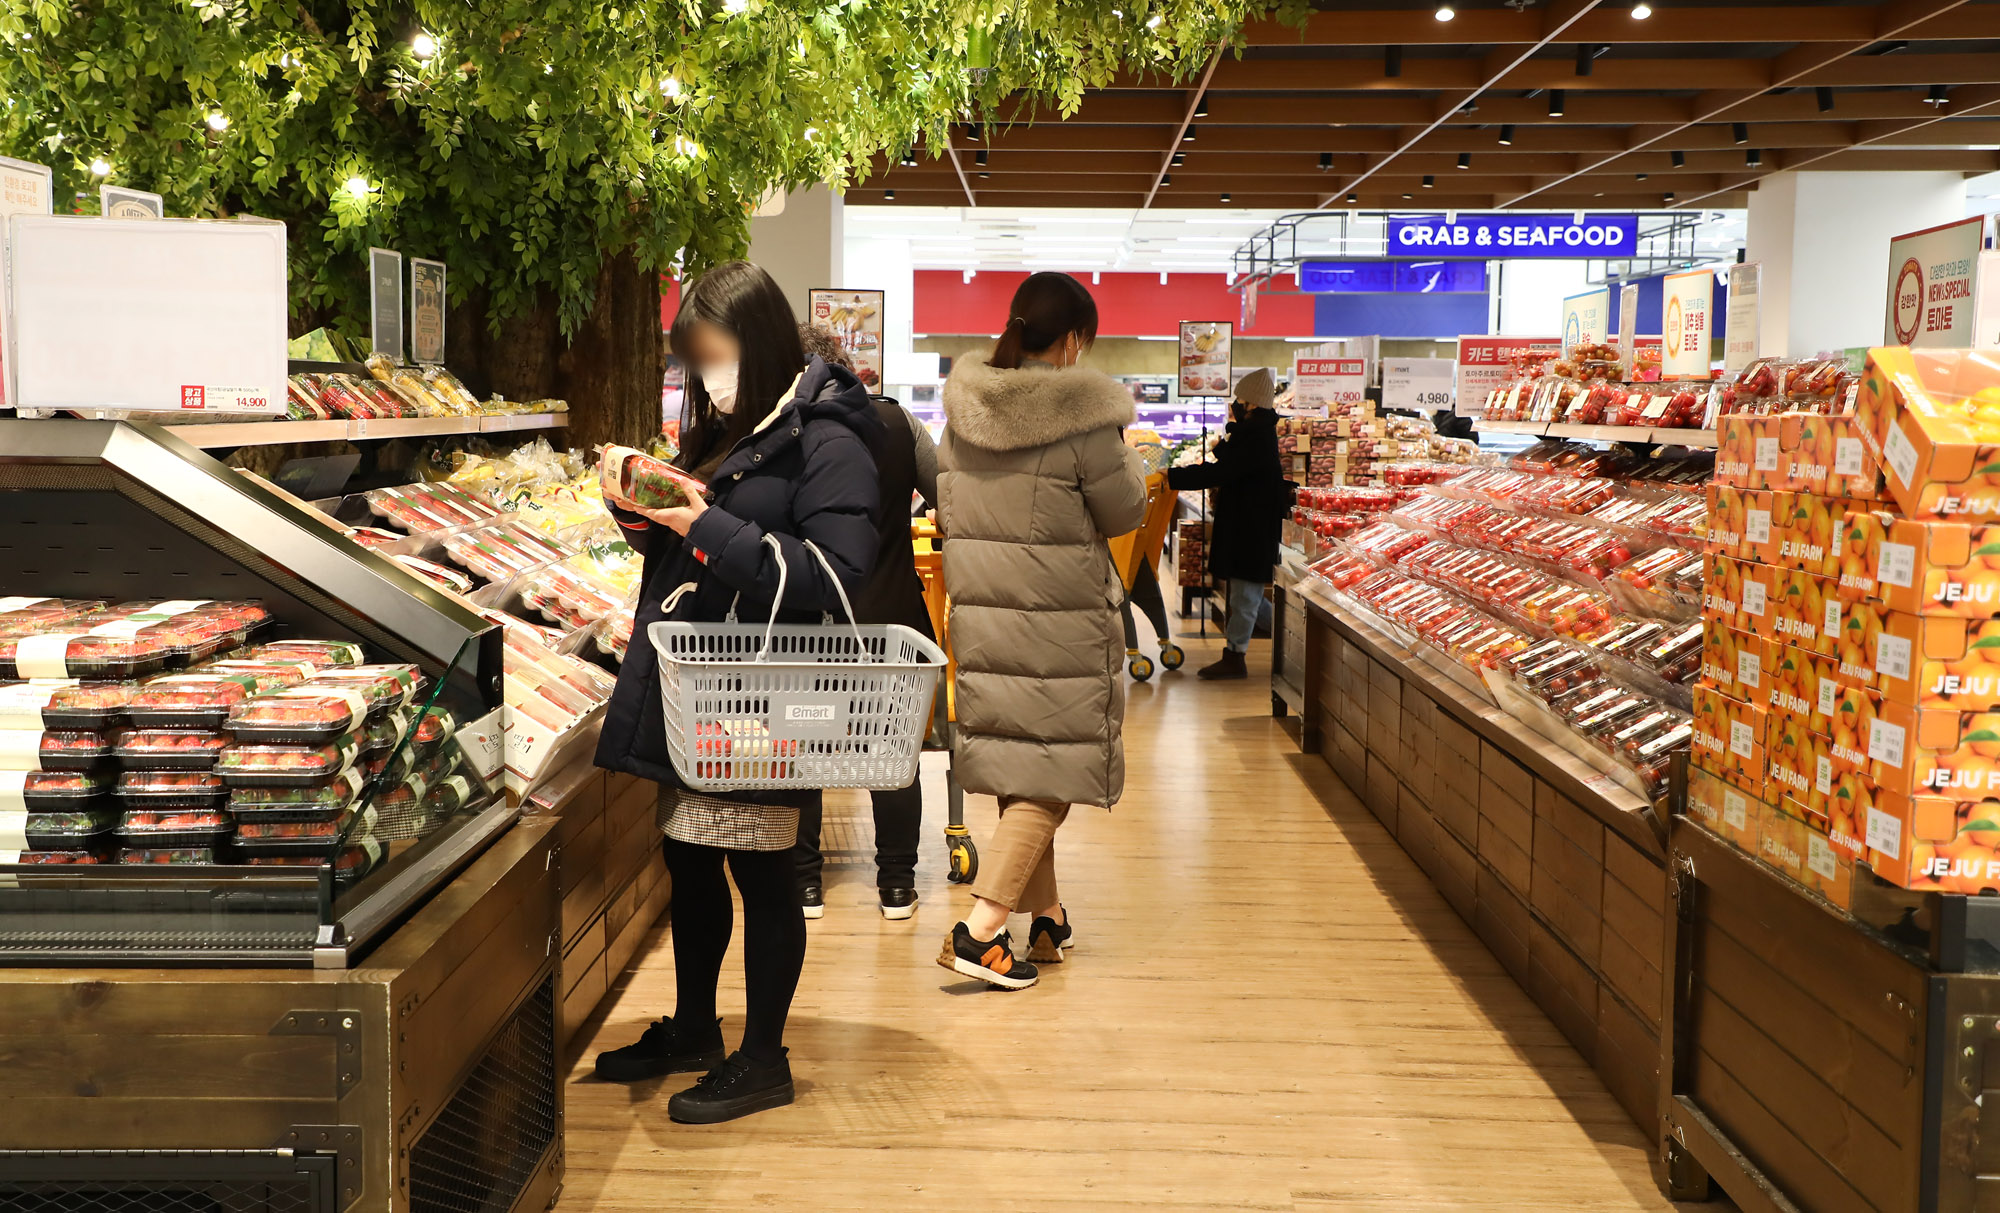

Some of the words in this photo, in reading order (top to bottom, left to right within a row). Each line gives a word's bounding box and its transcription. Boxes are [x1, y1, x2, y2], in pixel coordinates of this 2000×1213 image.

[1399, 226, 1470, 246] CRAB
[1475, 226, 1492, 246] &
[1497, 226, 1624, 246] SEAFOOD
[1929, 262, 1945, 280] 다양한
[1945, 260, 1957, 277] 맛과
[1927, 305, 1953, 332] 토마토
[1684, 333, 1698, 352] 토마토
[1468, 347, 1493, 362] 카드
[1301, 363, 1318, 373] 광고
[1319, 363, 1337, 373] 상품
[185, 387, 201, 397] 광고
[185, 397, 202, 406] 상품
[236, 397, 267, 407] 14,900
[1333, 391, 1361, 401] 7,900
[1416, 392, 1449, 404] 4,980
[1716, 461, 1732, 476] JEJU
[1731, 462, 1749, 477] FARM
[1787, 463, 1806, 477] JEJU
[1805, 464, 1827, 480] FARM
[1930, 494, 1992, 515] JEJU
[1706, 528, 1721, 543] JEJU
[1721, 531, 1739, 546] FARM
[1780, 540, 1800, 557] JEJU
[1800, 543, 1823, 562] FARM
[1839, 573, 1855, 588] JEJU
[1855, 575, 1873, 592] FARM
[1932, 581, 1993, 603] JEJU
[1703, 594, 1718, 610] JEJU
[1718, 597, 1736, 615] FARM
[1773, 615, 1793, 634] JEJU
[1793, 619, 1816, 640] FARM
[1702, 662, 1716, 680] JEJU
[1716, 667, 1732, 685] FARM
[1839, 662, 1855, 677] JEJU
[1854, 665, 1873, 682] FARM
[1930, 675, 1990, 695] JEJU
[1769, 688, 1788, 708] JEJU
[1787, 694, 1810, 716] FARM
[792, 707, 829, 718] emart
[1693, 729, 1707, 747] JEJU
[1706, 735, 1724, 755] FARM
[1831, 743, 1847, 761] JEJU
[1845, 747, 1865, 767] FARM
[1771, 763, 1789, 785] JEJU
[1788, 770, 1809, 793] FARM
[1921, 768, 1981, 789] JEJU
[1987, 771, 2000, 790] F
[1829, 829, 1846, 848] JEJU
[1844, 835, 1863, 854] FARM
[1920, 857, 1979, 877] JEJU
[1986, 861, 2000, 880] F
